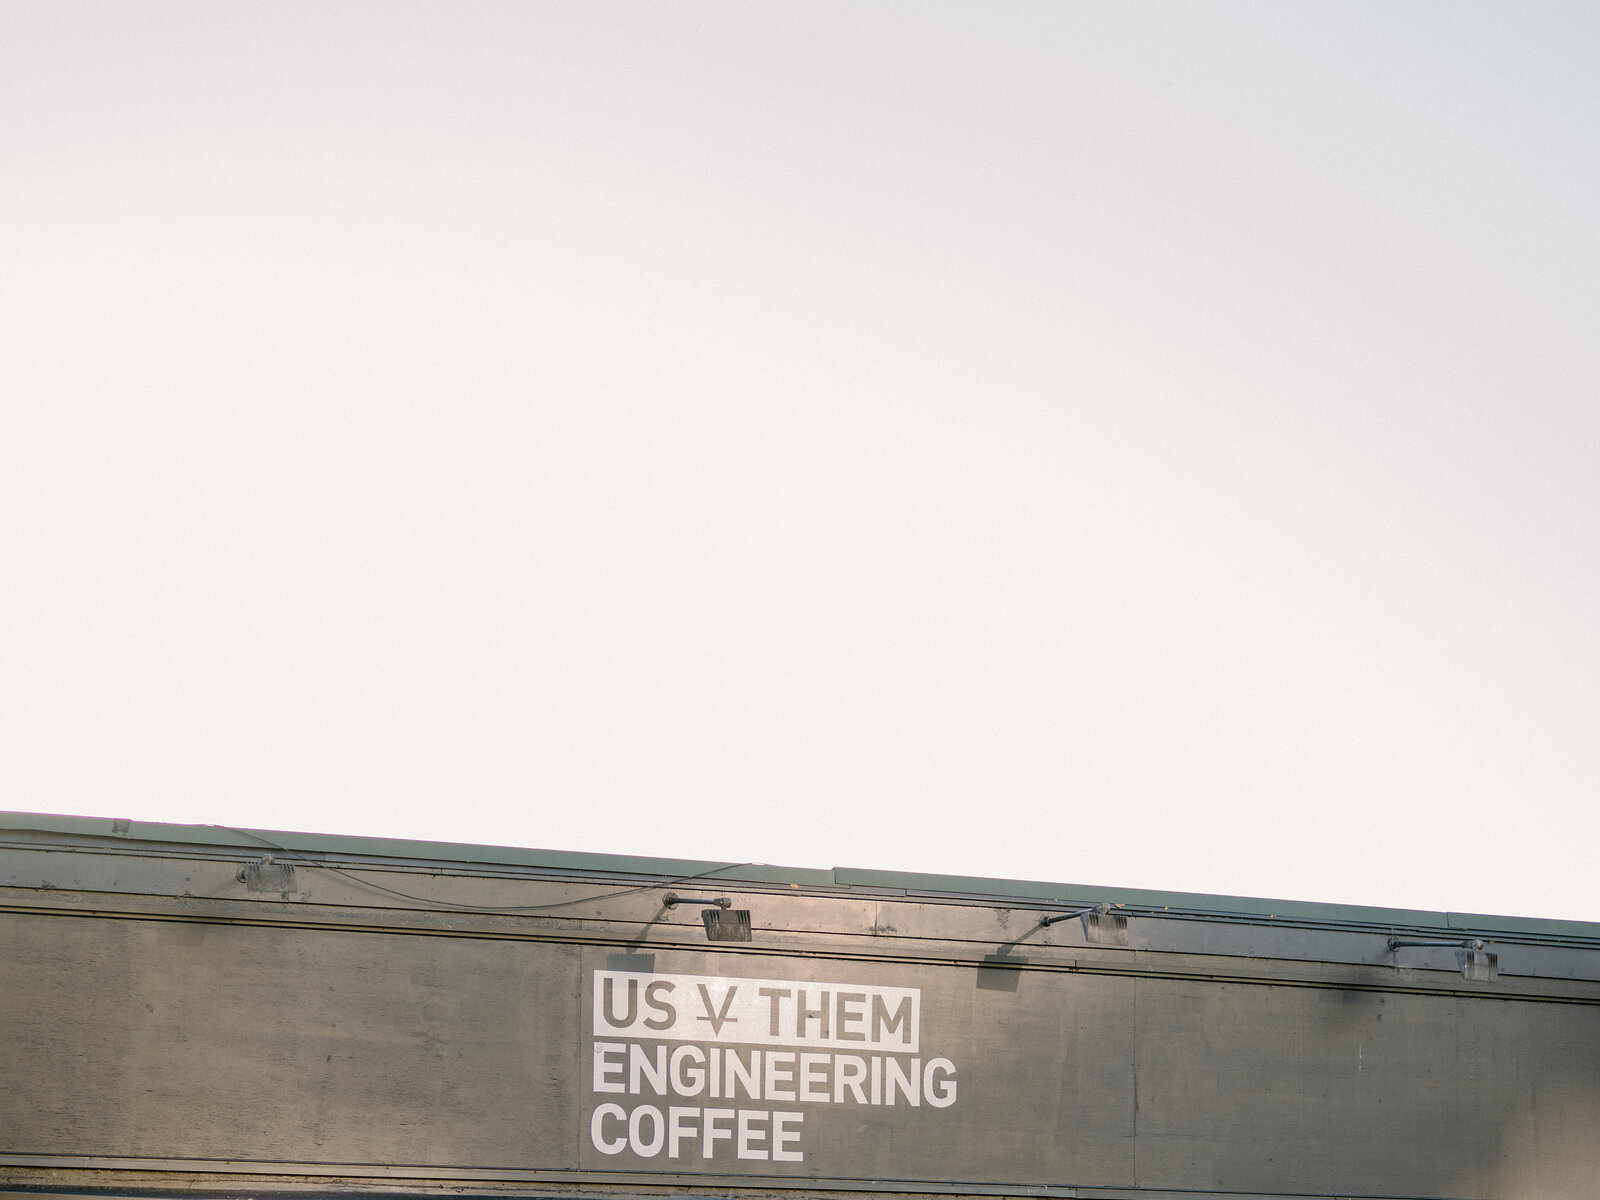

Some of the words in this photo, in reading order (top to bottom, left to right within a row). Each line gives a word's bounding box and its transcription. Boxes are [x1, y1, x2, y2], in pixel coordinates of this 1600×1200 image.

[601, 977, 677, 1030] US
[759, 988, 913, 1045] THEM
[593, 1042, 957, 1108] ENGINEERING
[590, 1102, 805, 1162] COFFEE
